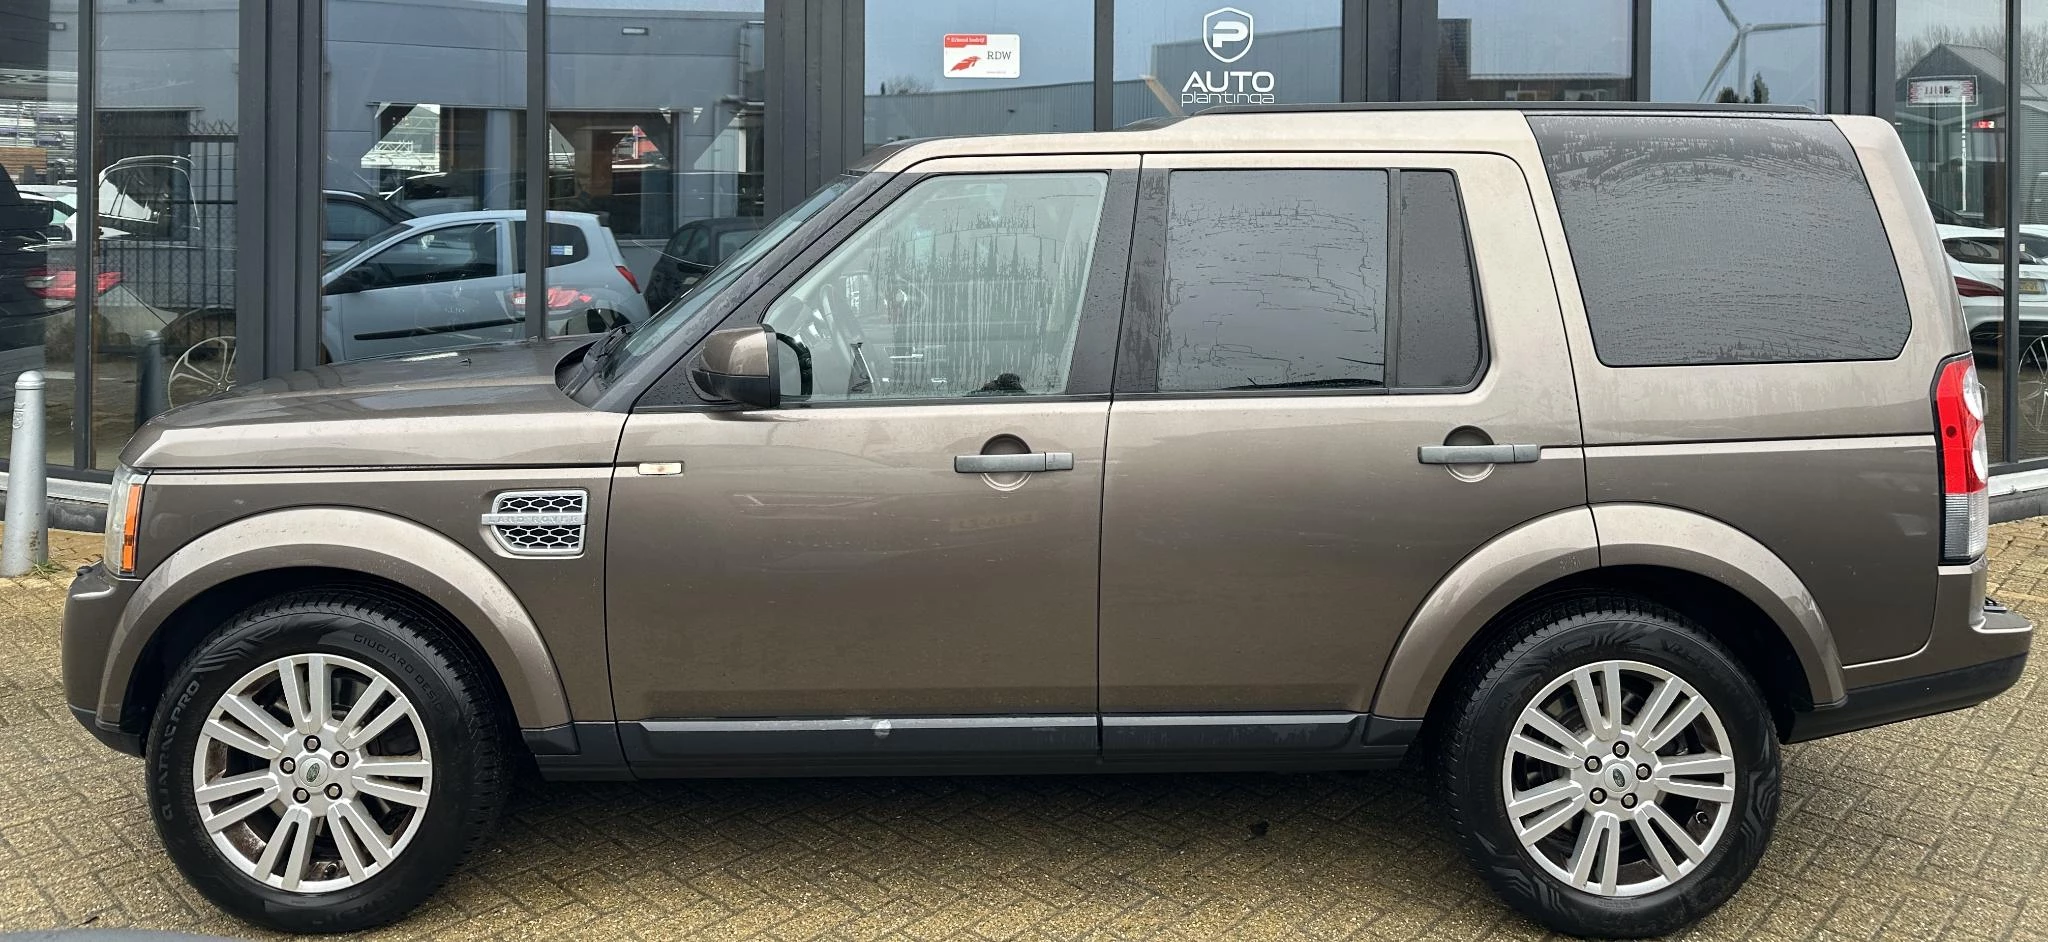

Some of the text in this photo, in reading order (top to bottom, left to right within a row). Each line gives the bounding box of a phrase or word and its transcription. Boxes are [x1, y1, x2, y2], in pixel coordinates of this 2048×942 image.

[987, 51, 1012, 60] RDW
[1182, 71, 1275, 93] AUTO
[1181, 91, 1275, 107] plantinga
[488, 516, 579, 524] LAND ROVER
[353, 633, 414, 674] GIUGIARO
[171, 679, 200, 723] PRO
